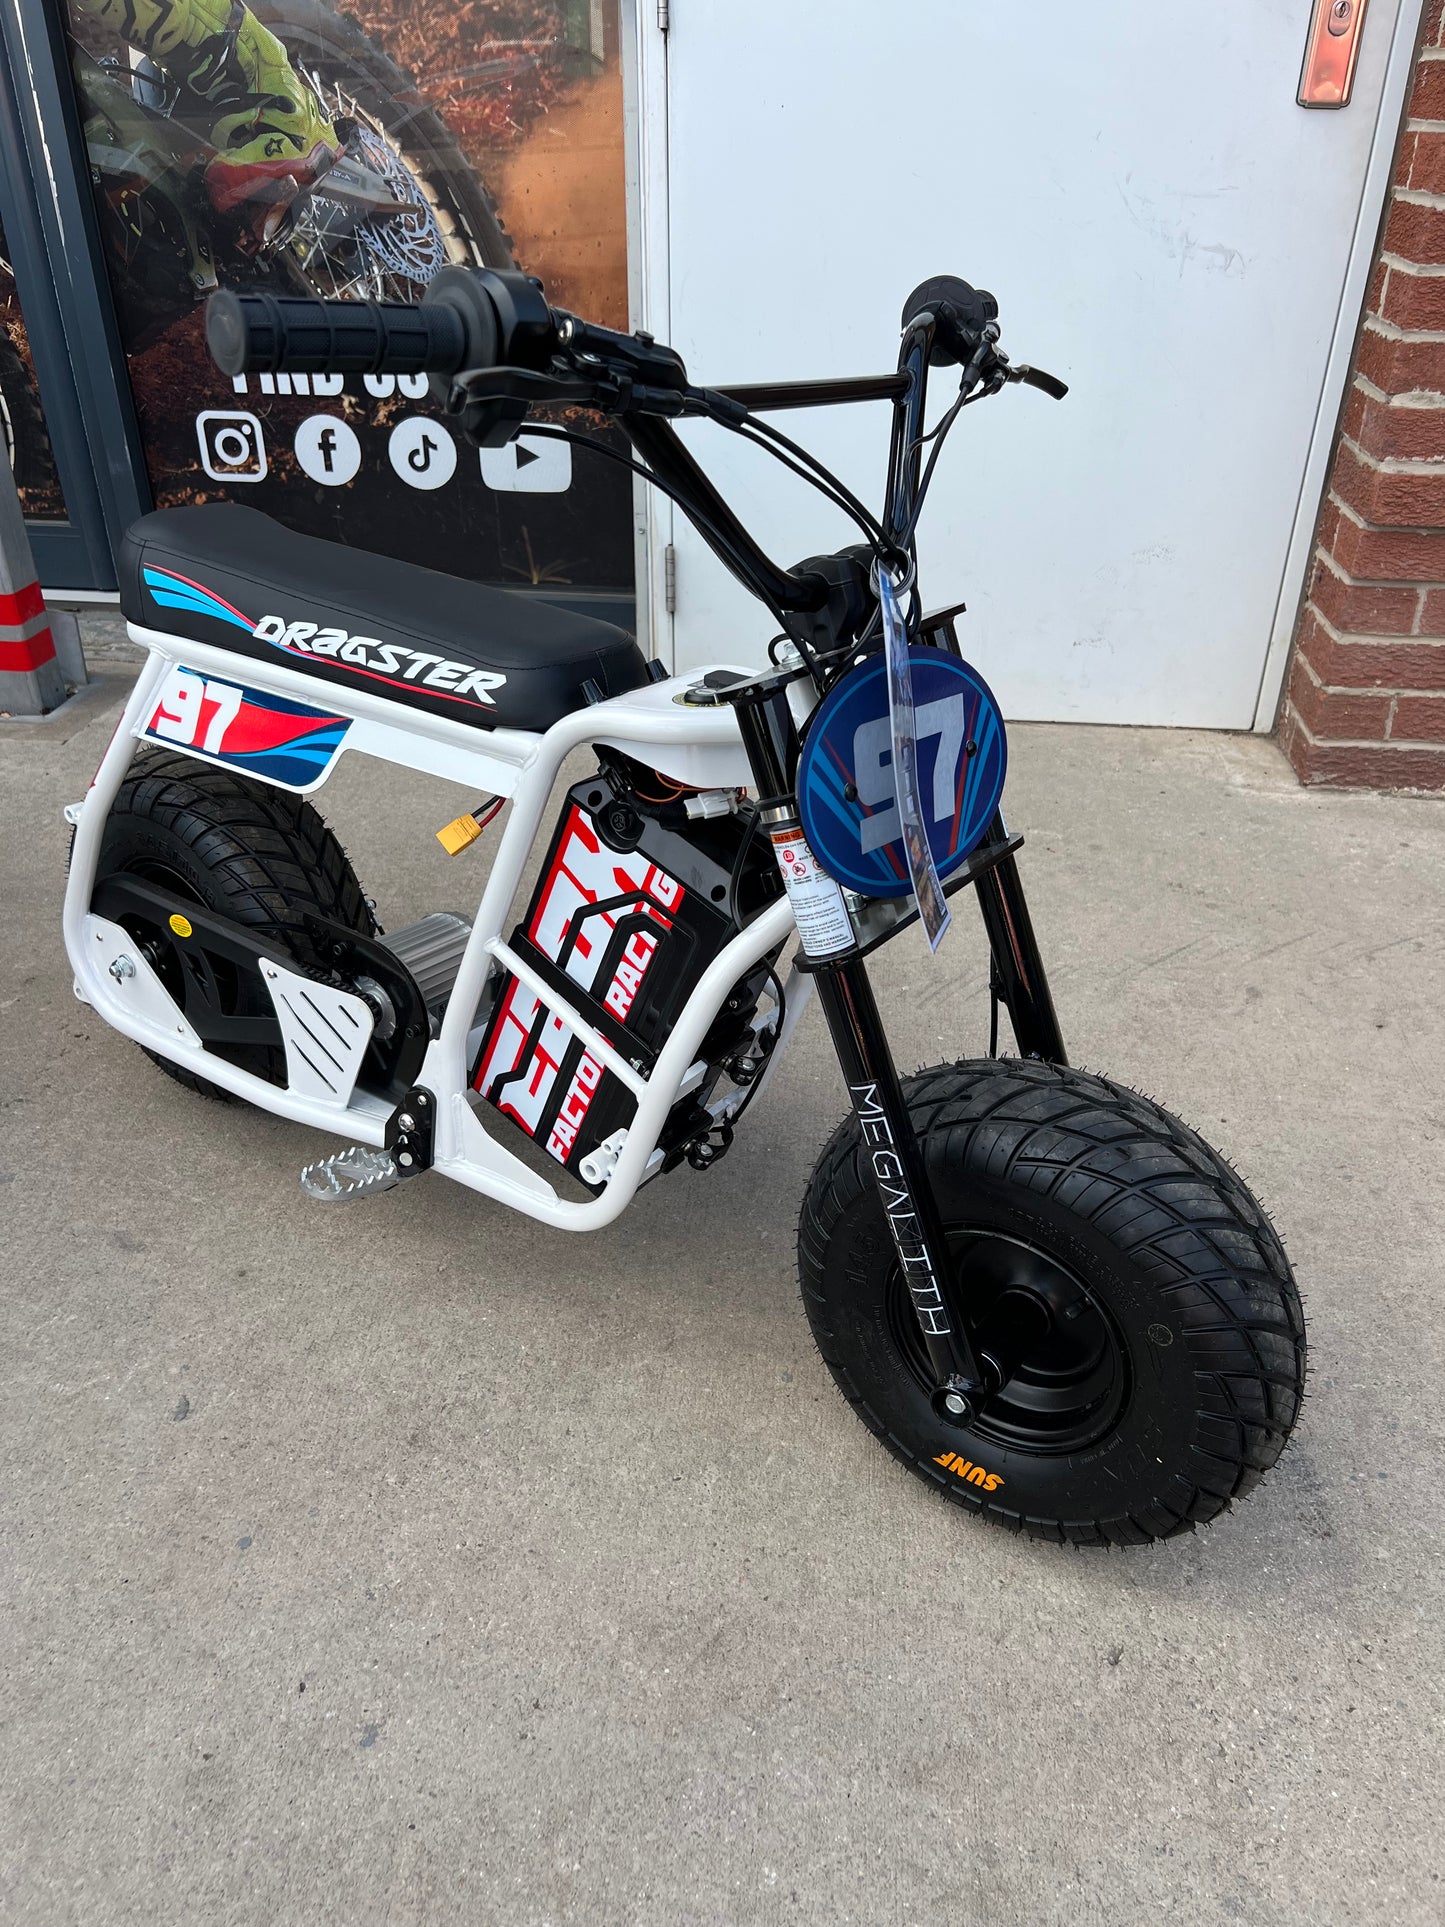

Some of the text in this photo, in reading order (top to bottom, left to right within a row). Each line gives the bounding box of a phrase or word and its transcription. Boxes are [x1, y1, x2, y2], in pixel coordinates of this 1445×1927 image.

[156, 669, 243, 755] 97
[854, 693, 964, 855] 97
[544, 866, 682, 1166] FACTO RACIG
[850, 1082, 951, 1335] MEGALITH
[930, 1451, 1006, 1492] SUNF
